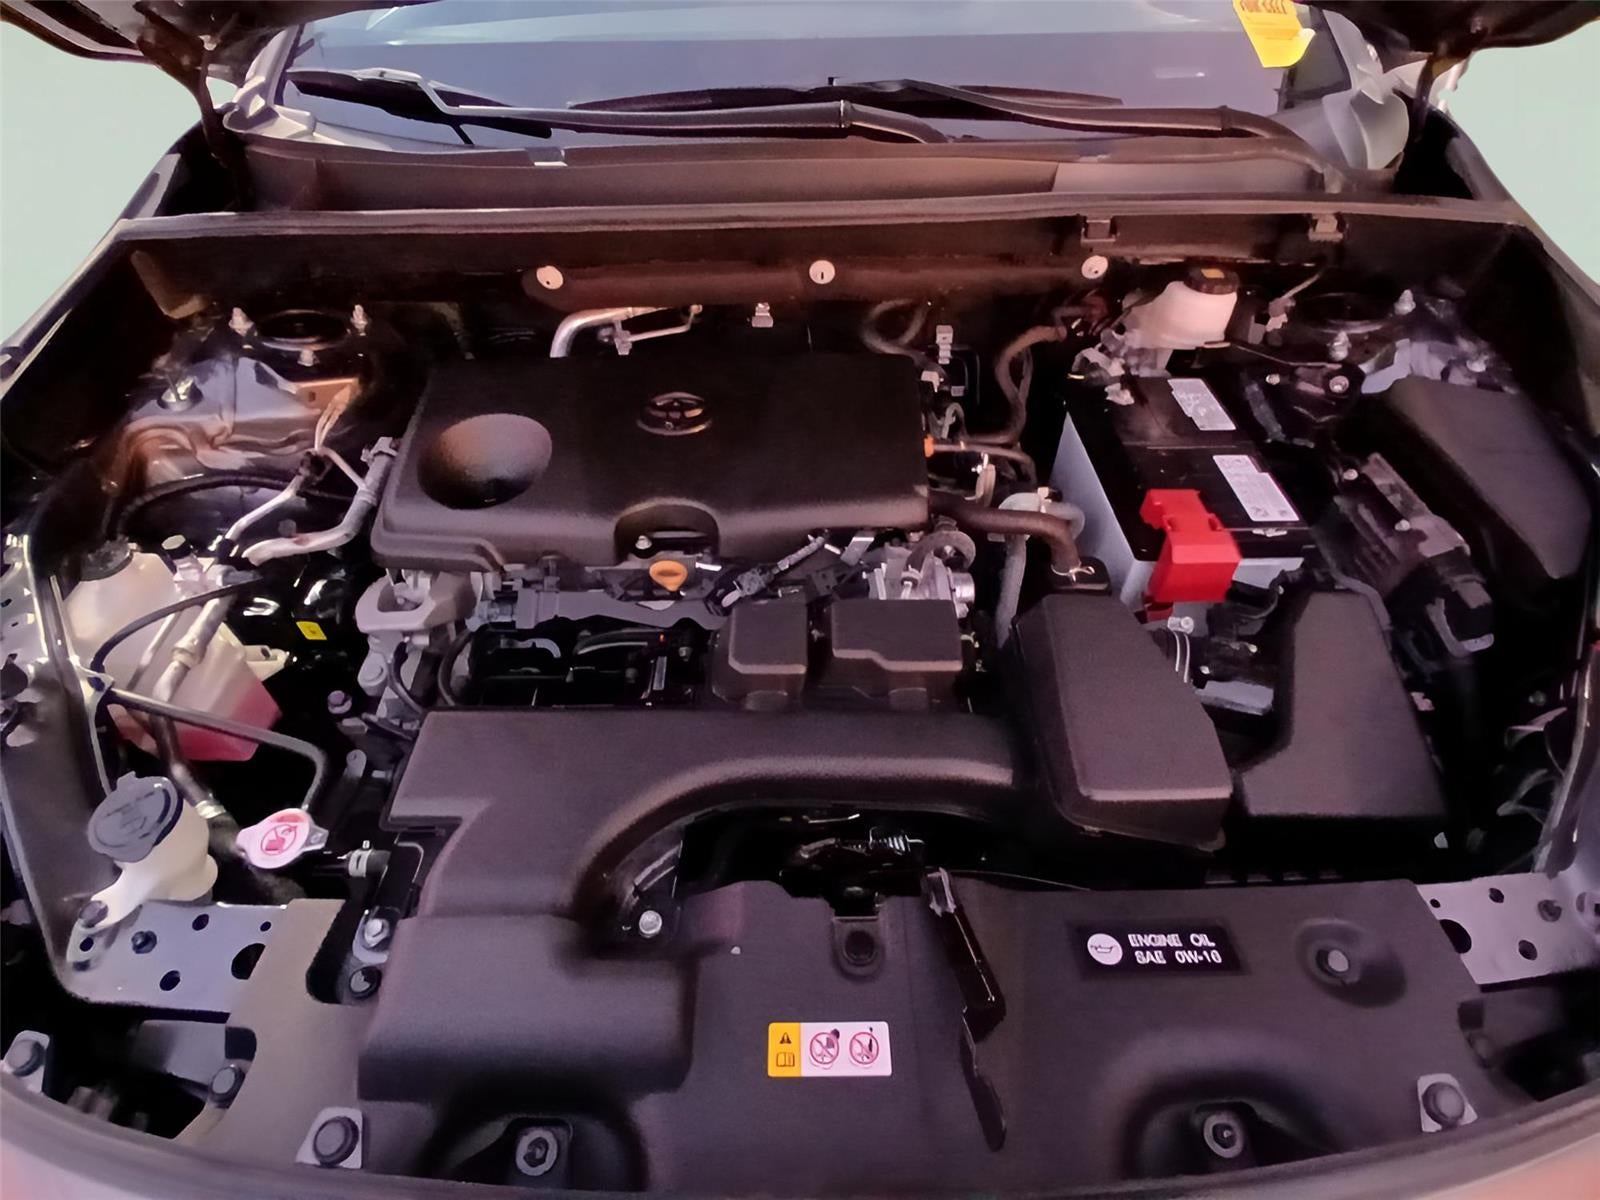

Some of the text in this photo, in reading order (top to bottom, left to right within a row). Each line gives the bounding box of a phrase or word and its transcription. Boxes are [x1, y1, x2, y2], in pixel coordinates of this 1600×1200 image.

[1127, 933, 1216, 947] ENGINE OIL
[1134, 950, 1167, 964] SAE
